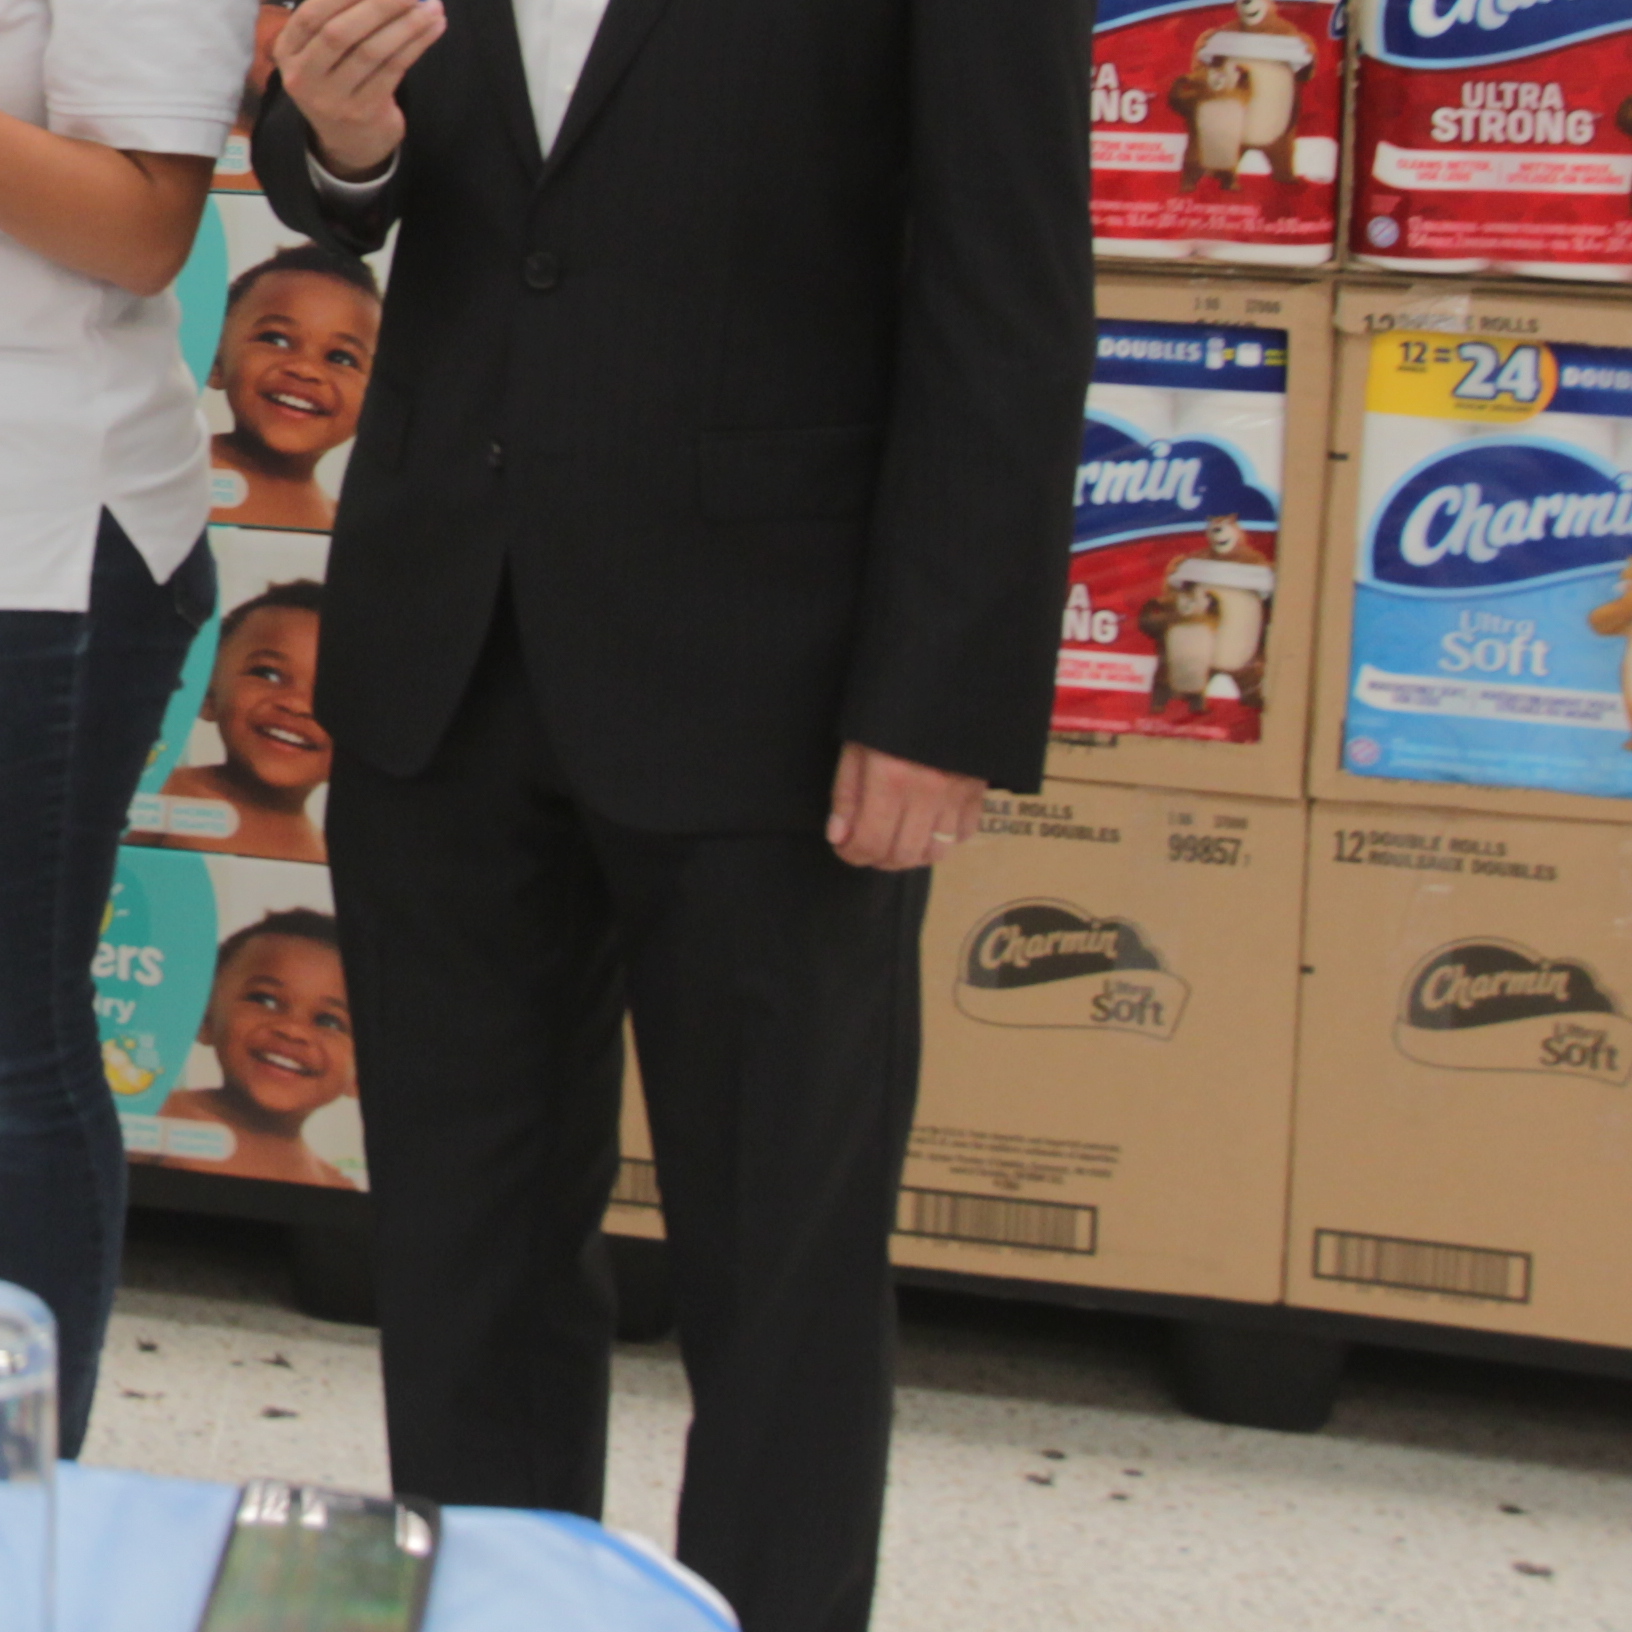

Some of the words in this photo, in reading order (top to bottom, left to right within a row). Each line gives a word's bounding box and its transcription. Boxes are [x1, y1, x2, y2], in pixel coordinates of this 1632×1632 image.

[1461, 80, 1565, 110] ULTRA
[1430, 106, 1597, 145] STRONG
[1097, 336, 1203, 362] DOUBLES
[1400, 341, 1428, 364] 12
[1452, 341, 1543, 402] 24
[1072, 440, 1203, 510] rmin
[1460, 609, 1536, 638] Ultra
[1438, 631, 1550, 678] Soft
[1017, 801, 1075, 821] ROLLS
[978, 818, 1033, 836] LEAUX
[1039, 822, 1121, 844] DOUBLES
[1333, 829, 1366, 864] 12
[1368, 829, 1443, 852] DOUBLE
[1449, 836, 1508, 858] ROLLS
[1471, 858, 1557, 882] DOUBLES
[979, 920, 1121, 970] Charmin
[1420, 961, 1572, 1011] Charmin
[1089, 990, 1166, 1026] Soft
[1538, 1033, 1619, 1071] Soft
